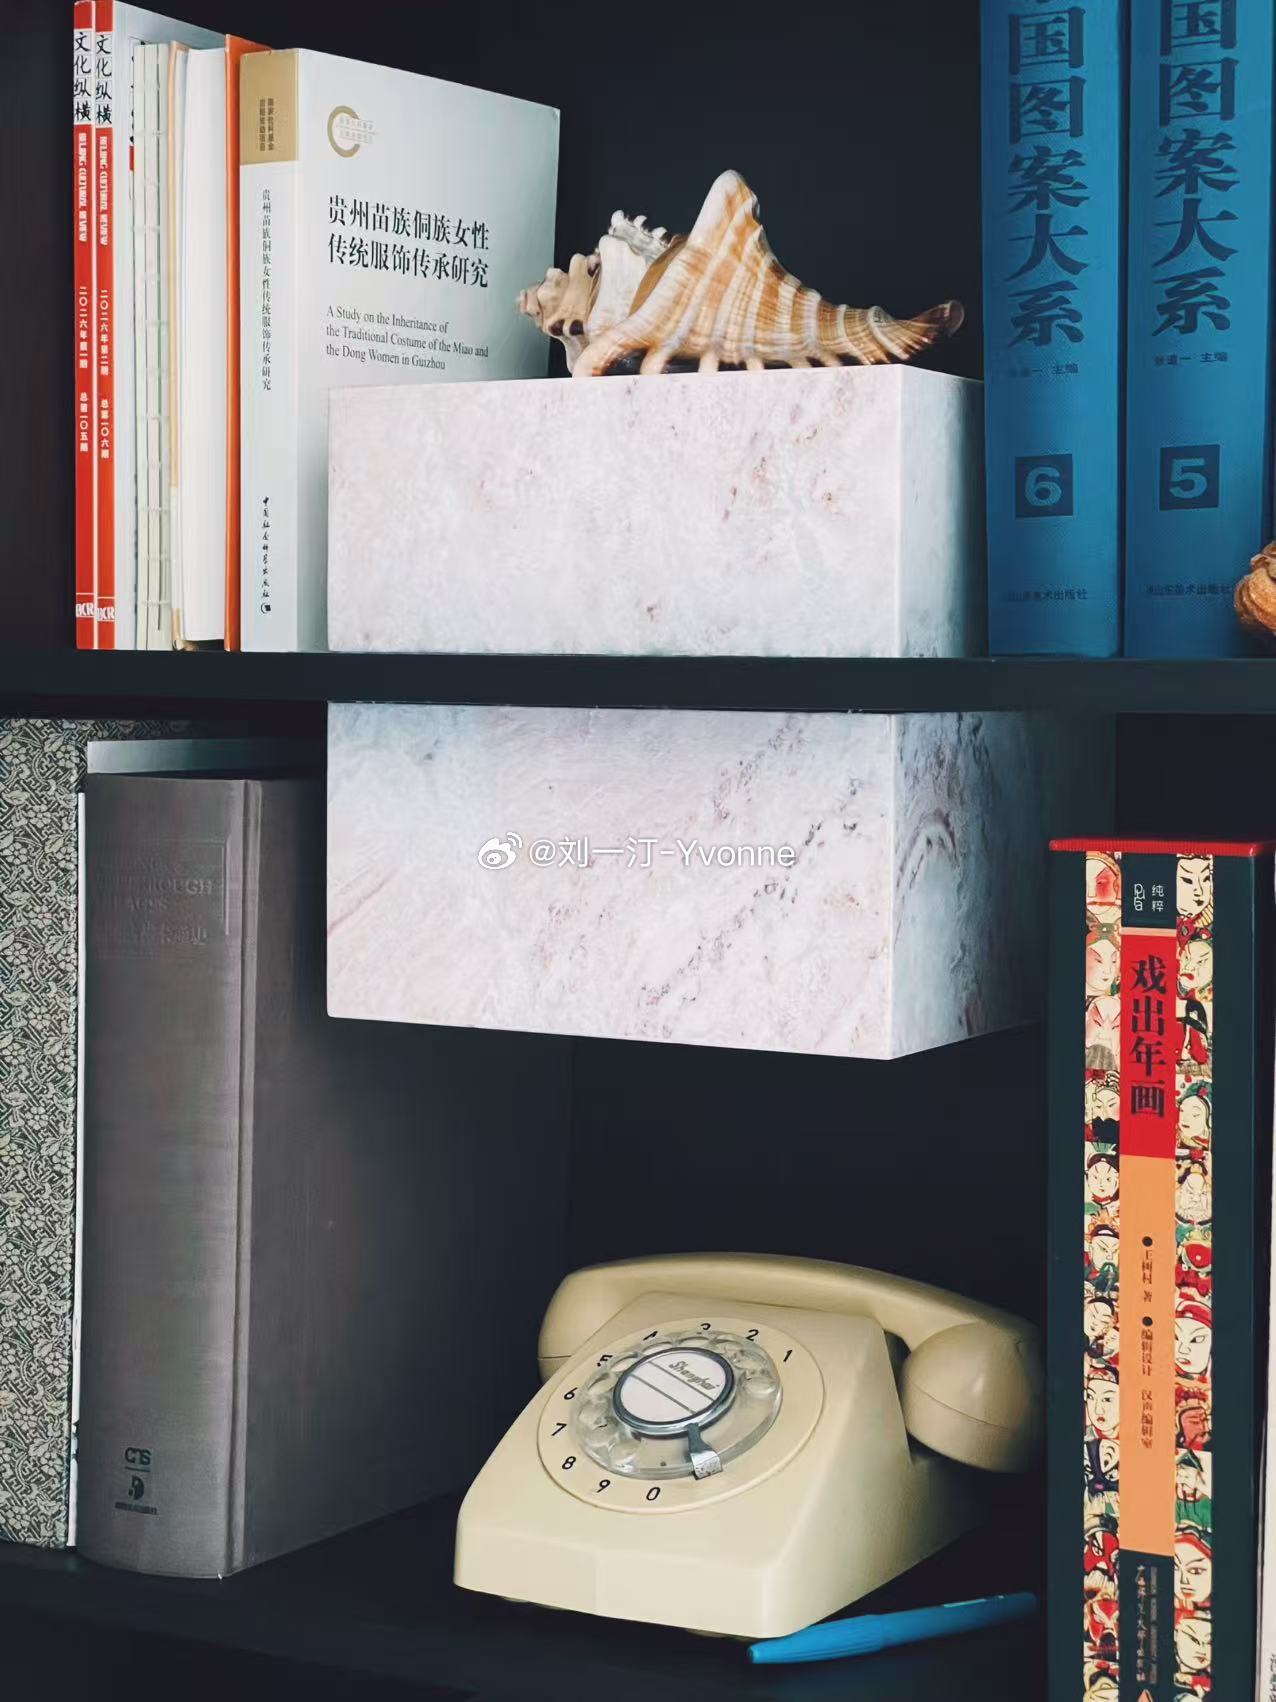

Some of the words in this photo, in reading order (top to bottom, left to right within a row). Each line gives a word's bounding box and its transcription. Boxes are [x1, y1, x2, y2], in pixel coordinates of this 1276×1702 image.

[74, 31, 91, 122] 文化纵横
[96, 34, 112, 125] 文化纵横
[78, 210, 87, 242] REVIEW
[99, 214, 109, 246] REVIEW
[327, 195, 490, 251] 贵州苗族侗族女性
[327, 233, 488, 288] 传统服饰传承研究
[327, 305, 334, 317] A
[337, 306, 361, 324] Study
[363, 312, 374, 323] on
[377, 312, 390, 325] the
[392, 314, 437, 332] Inheritance
[439, 322, 449, 334] of
[326, 324, 339, 337] the
[342, 326, 388, 344] Traditional
[390, 333, 426, 349] Costume
[428, 339, 437, 351] of
[438, 339, 451, 352] the
[453, 341, 473, 355] Miao
[474, 346, 489, 358] and
[326, 343, 339, 356] the
[342, 345, 366, 363] Dong
[368, 348, 400, 364] Women
[402, 355, 410, 365] in
[411, 354, 446, 370] Guizhou
[1024, 466, 1063, 507] 6
[1168, 457, 1208, 499] 5
[1129, 954, 1167, 1119] 戏出年画
[745, 1329, 759, 1342] 2
[783, 1349, 793, 1363] 1
[564, 1387, 578, 1400] 6
[551, 1422, 567, 1437] 7
[562, 1456, 576, 1470] 8
[596, 1479, 611, 1493] 9
[646, 1486, 661, 1501] 0
